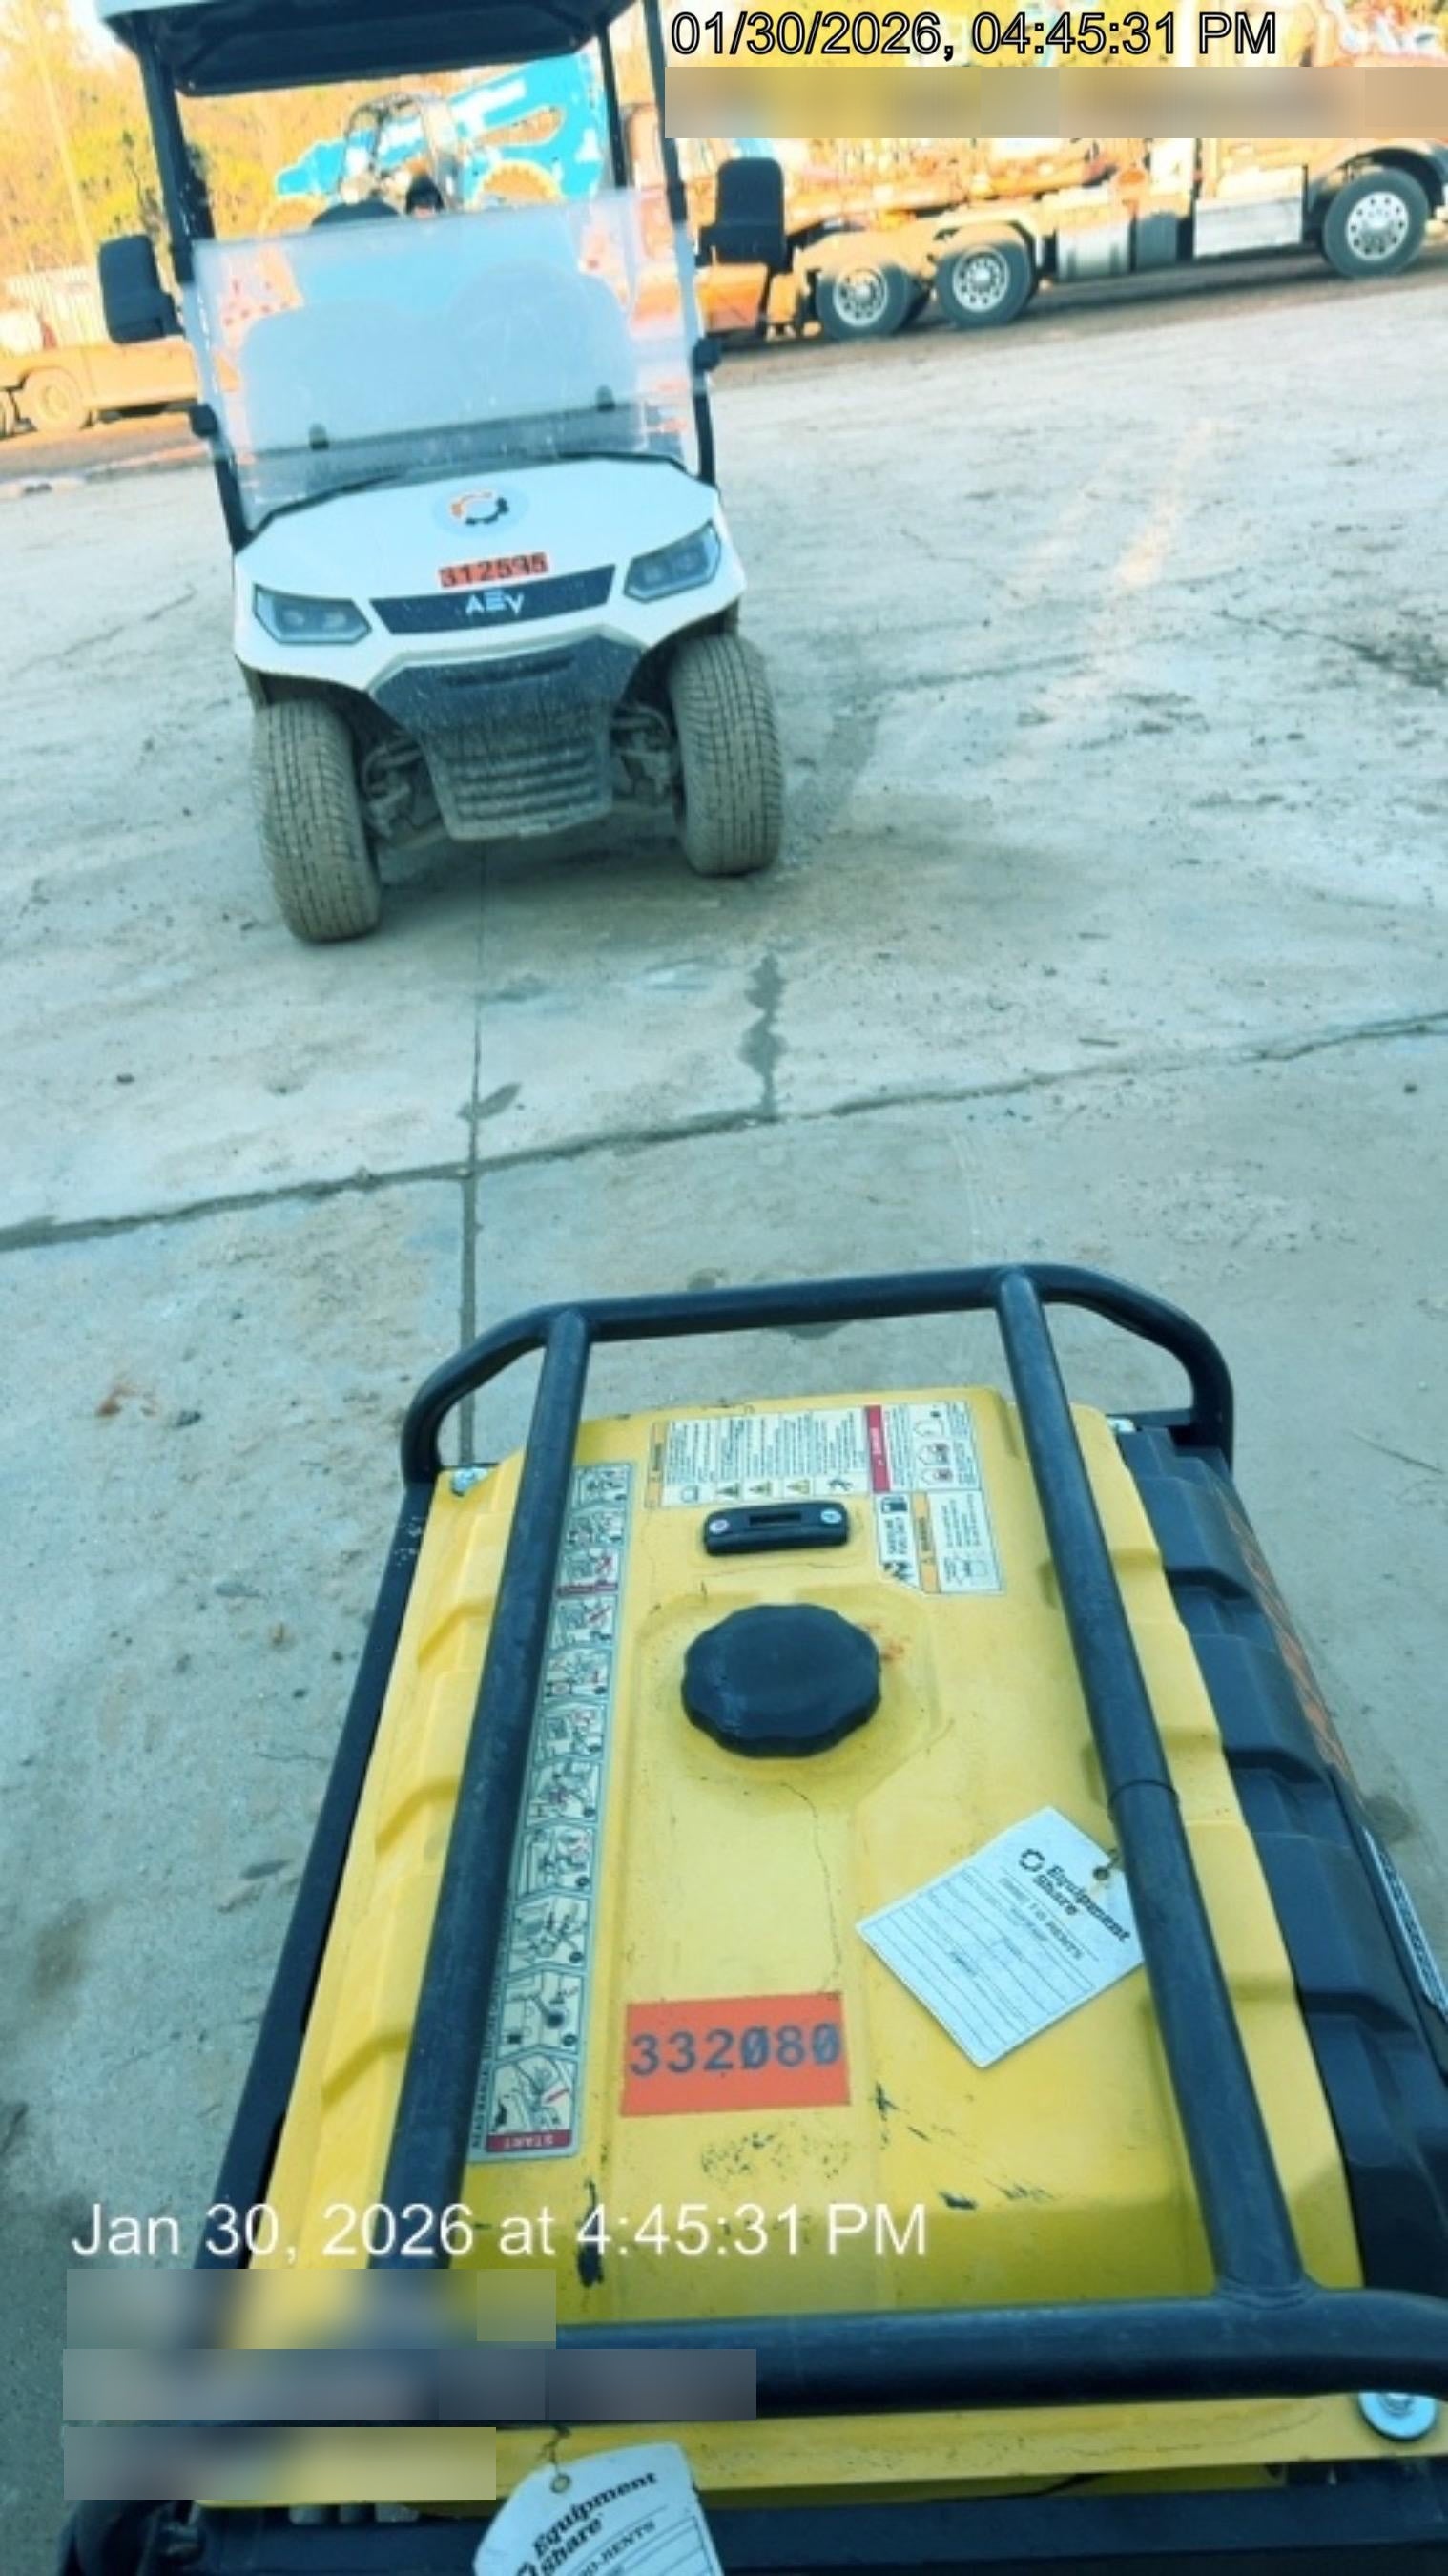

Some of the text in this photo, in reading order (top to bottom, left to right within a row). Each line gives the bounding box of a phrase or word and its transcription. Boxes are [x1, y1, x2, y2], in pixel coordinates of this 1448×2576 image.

[1032, 1873, 1079, 1916] Share
[1046, 1865, 1130, 1942] Equipment
[630, 2020, 841, 2076] 332080
[532, 2472, 657, 2558] Equipment
